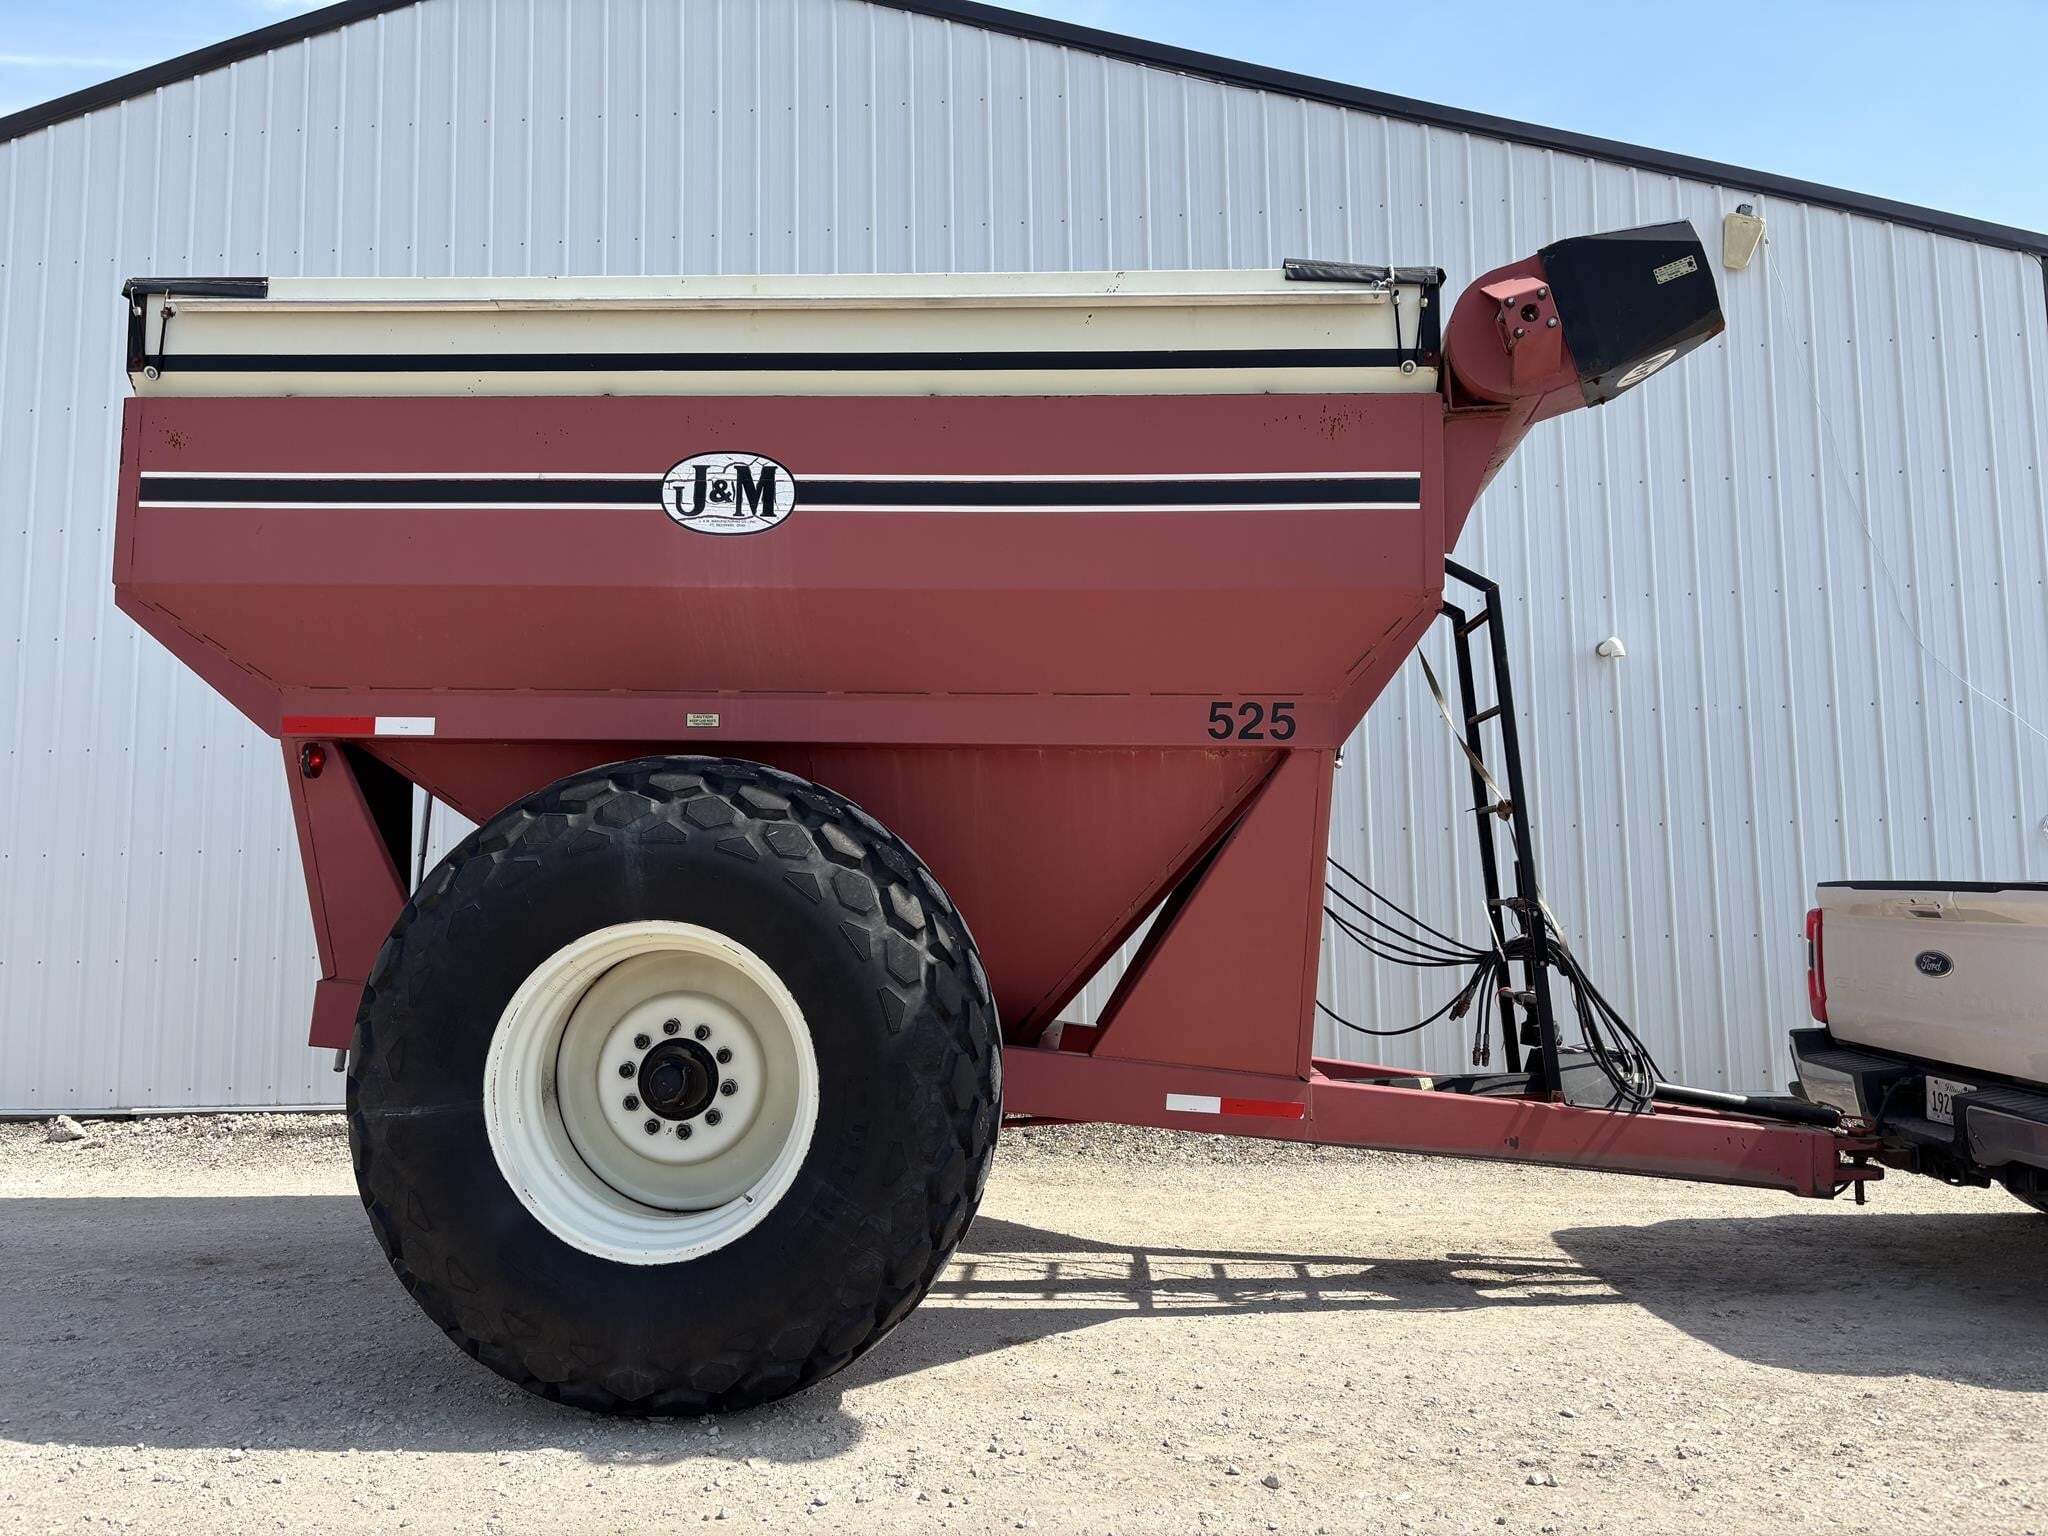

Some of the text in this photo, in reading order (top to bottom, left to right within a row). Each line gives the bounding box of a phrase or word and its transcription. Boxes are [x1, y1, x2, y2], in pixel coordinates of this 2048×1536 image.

[672, 465, 778, 517] J&M
[1207, 702, 1296, 740] 525
[1920, 955, 1943, 972] Ford
[1932, 1090, 1954, 1116] 192
